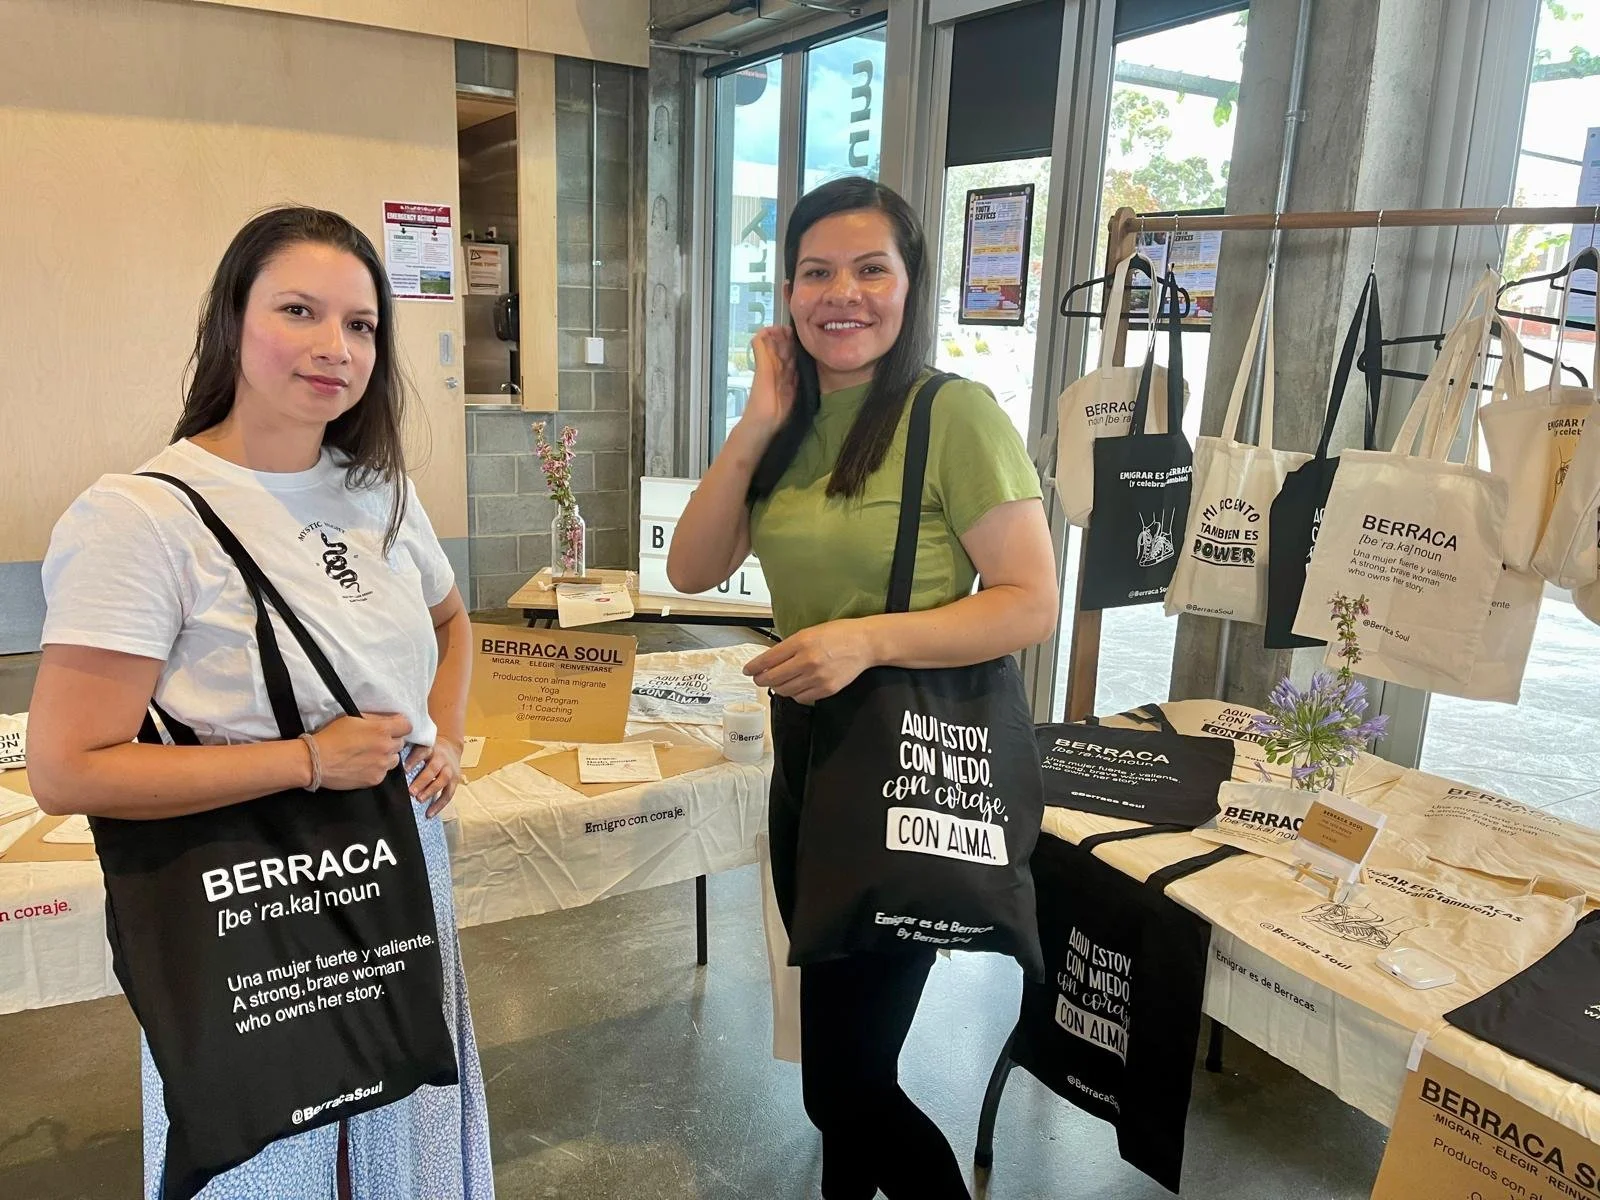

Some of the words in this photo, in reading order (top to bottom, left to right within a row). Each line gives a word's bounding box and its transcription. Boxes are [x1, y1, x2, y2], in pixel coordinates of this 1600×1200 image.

[387, 212, 416, 221] EMERGENCY
[975, 212, 996, 220] SERVICES
[1085, 400, 1137, 418] BERRAC
[1120, 471, 1153, 480] EMIGRAR
[1155, 472, 1165, 480] ES
[1169, 465, 1192, 476] ERRACA
[1202, 504, 1218, 521] MI
[1220, 498, 1260, 522] ACENTO
[297, 521, 323, 541] MYSTIC
[1201, 522, 1239, 539] TAMBIEN
[1244, 530, 1259, 540] ES
[1362, 514, 1457, 552] BERRACA
[1193, 539, 1255, 563] POWER
[1352, 549, 1370, 559] Una
[1372, 552, 1397, 566] mujer
[1399, 557, 1419, 570] fuerte
[1413, 546, 1442, 562] noun
[1348, 567, 1366, 577] who
[1367, 572, 1391, 582] owns
[1392, 576, 1405, 586] her
[1405, 581, 1425, 594] story.
[1390, 566, 1411, 578] brave
[1412, 574, 1440, 587] woman
[1394, 630, 1411, 642] Soul
[481, 638, 569, 659] BERRACA
[574, 647, 623, 664] SOUL
[492, 672, 532, 683] Productos
[551, 677, 570, 685] alma
[572, 679, 606, 688] migrante
[540, 686, 560, 695] Yoga
[517, 693, 543, 702] Online
[545, 696, 579, 706] Program
[638, 688, 665, 697] CON
[516, 712, 573, 723] @berracasoul
[535, 703, 573, 715] Coaching
[1218, 714, 1245, 724] CON
[1223, 708, 1251, 719] AQUI
[900, 709, 940, 744] AQUI
[940, 721, 992, 754] ESTOY.
[1208, 726, 1237, 738] CON
[1054, 738, 1170, 765] BERRACA
[899, 740, 936, 776] CON
[941, 748, 993, 788] MIEDO.
[1045, 756, 1066, 764] Una
[1067, 760, 1096, 769] mujer
[1098, 765, 1127, 775] fuerte
[1063, 768, 1091, 778] owns
[1118, 759, 1154, 767] noun
[1089, 769, 1117, 777] brave
[1120, 775, 1158, 783] woman
[882, 775, 930, 800] con
[935, 782, 1009, 824] coraje.
[585, 819, 627, 833] Emigro
[627, 815, 648, 826] con
[650, 807, 685, 821] coraje.
[1224, 806, 1304, 832] BERRAC
[1473, 819, 1490, 828] her
[898, 814, 939, 849] CON
[947, 822, 996, 861] ALMA.
[1276, 831, 1298, 841] nou
[202, 838, 397, 903] BERRACA
[324, 882, 380, 907] noun
[1374, 878, 1434, 899] celebrarlo
[14, 899, 72, 920] coraje.
[875, 912, 918, 926] Emigrar
[919, 919, 932, 928] es
[934, 920, 949, 931] de
[896, 927, 912, 940] By
[1068, 926, 1090, 960] AQUI
[1092, 943, 1132, 980] ESTOY.
[1259, 921, 1320, 955] @Berraca
[1321, 953, 1352, 971] Soul
[227, 972, 263, 992] Una
[266, 959, 312, 984] mujer
[315, 948, 357, 970] fuerte
[361, 948, 371, 964] y
[373, 932, 435, 958] valiente.
[232, 996, 247, 1012] A
[248, 982, 305, 1008] strong,
[306, 972, 349, 993] brave
[352, 960, 405, 981] woman
[1057, 970, 1078, 996] con
[1066, 949, 1085, 984] CON
[1089, 966, 1131, 1007] MIEDO.
[1216, 950, 1247, 973] Emigrar
[1249, 971, 1259, 982] es
[1261, 976, 1272, 989] de
[1274, 982, 1318, 1013] Berracas.
[235, 1013, 271, 1034] who
[275, 1000, 316, 1022] owns
[317, 993, 344, 1010] her
[345, 982, 385, 1003] story.
[1060, 1002, 1085, 1035] CON
[1089, 1019, 1127, 1053] ALMA
[291, 1080, 383, 1125] @BerracaSoul
[1421, 1077, 1565, 1174] BERRACA
[1433, 1137, 1498, 1181] Productos
[1501, 1176, 1526, 1196] con
